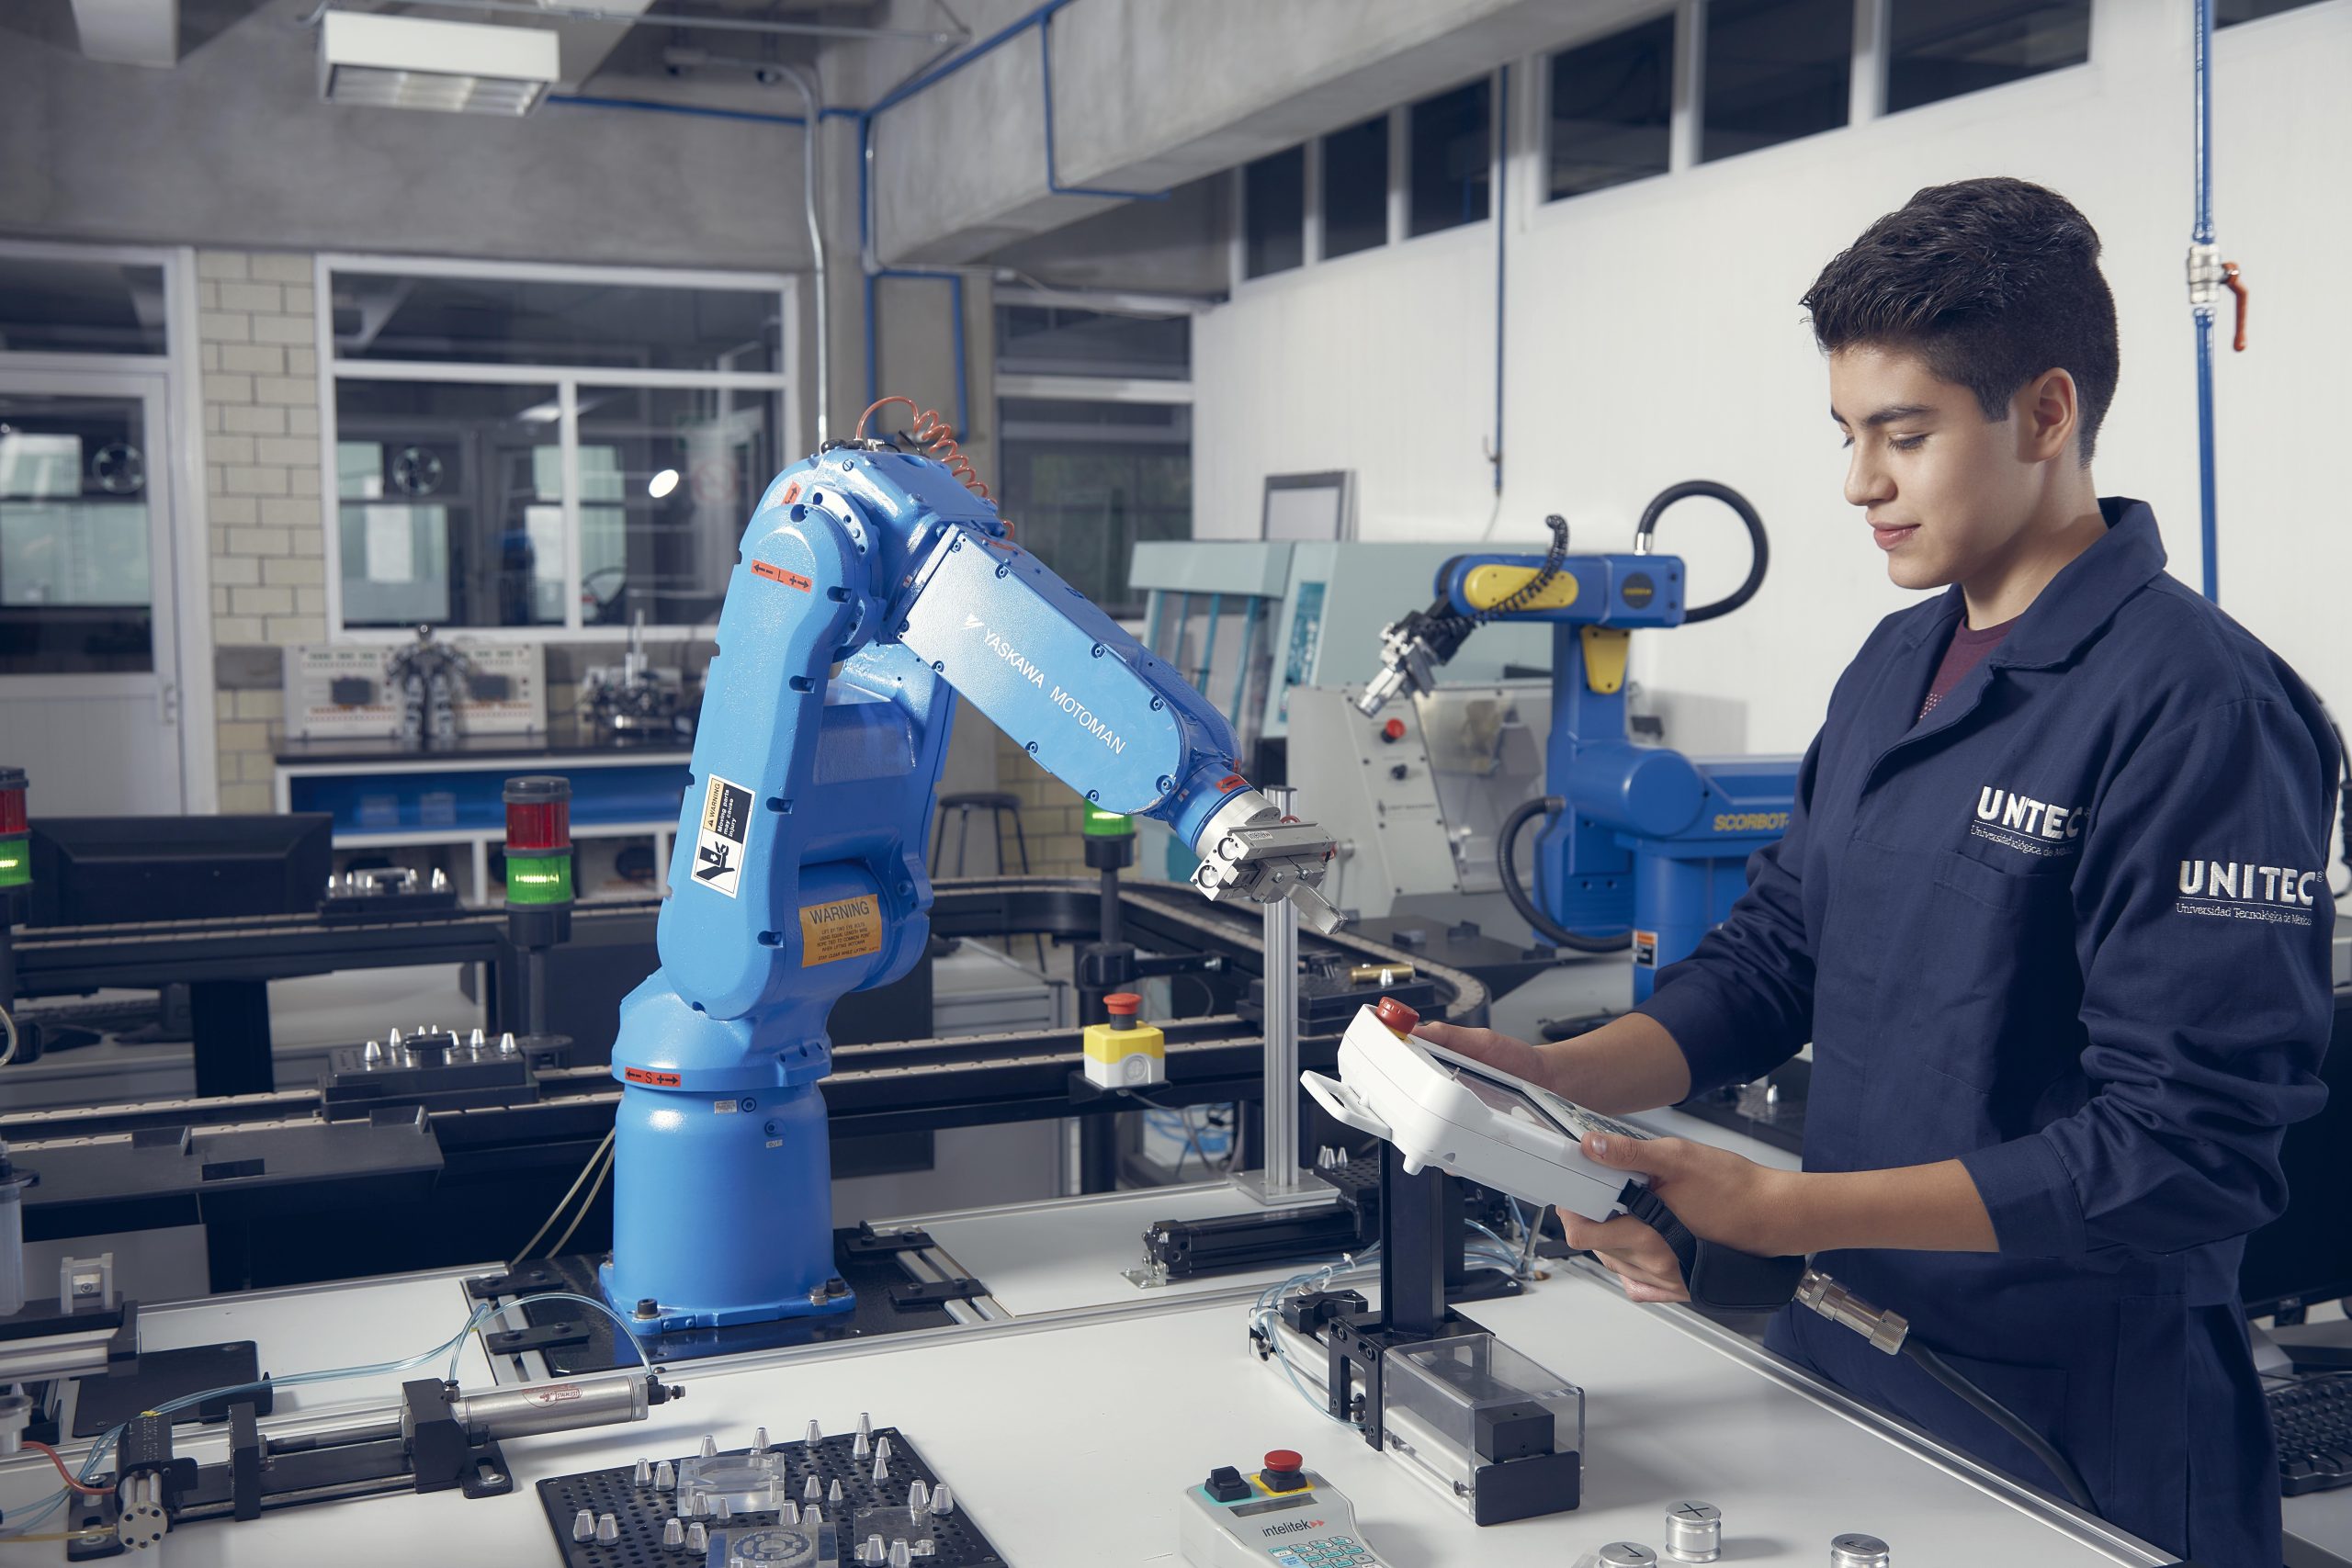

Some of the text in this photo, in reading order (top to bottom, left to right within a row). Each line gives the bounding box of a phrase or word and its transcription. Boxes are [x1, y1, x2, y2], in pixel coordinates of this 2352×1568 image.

[777, 569, 784, 583] L
[984, 628, 1126, 754] YASKAWA MOTOMAN
[709, 784, 720, 818] WARNING
[717, 808, 727, 833] Moving
[728, 818, 737, 838] injury
[2178, 860, 2316, 906] UNITEC
[809, 901, 870, 925] WARNING
[2176, 902, 2231, 918] Universidad
[2233, 907, 2282, 924] Tecnológica
[645, 1071, 653, 1085] S
[1261, 1519, 1311, 1538] intelitek
